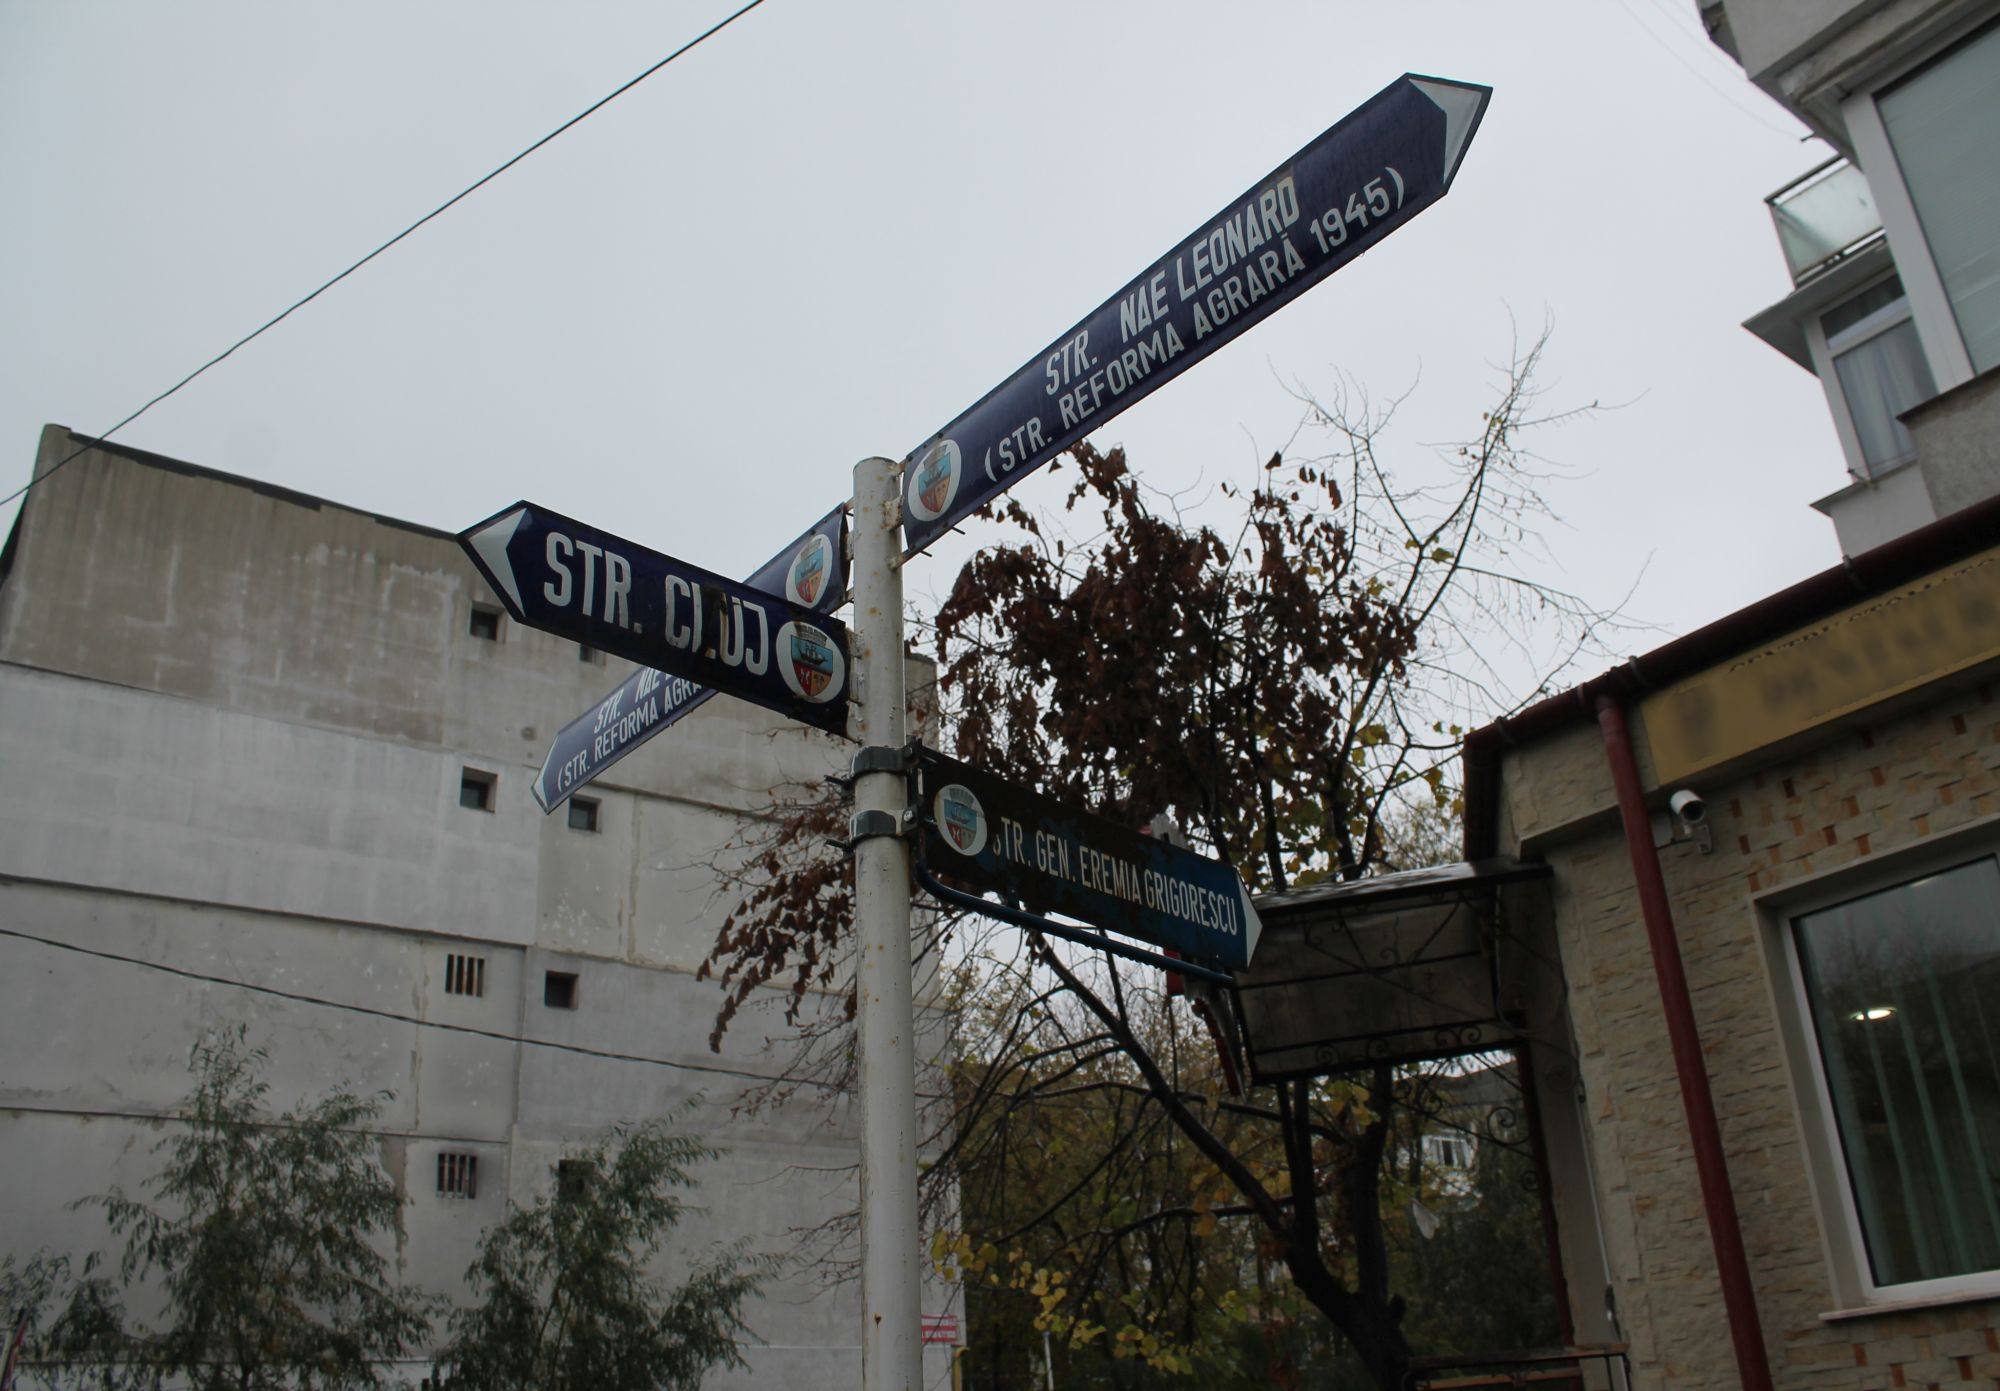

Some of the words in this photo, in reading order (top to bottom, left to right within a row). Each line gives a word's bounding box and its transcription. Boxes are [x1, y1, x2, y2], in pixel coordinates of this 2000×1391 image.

[985, 416, 1053, 482] (STR.
[1058, 322, 1185, 430] REFORMA
[1193, 232, 1306, 340] AGRARĂ
[1310, 167, 1404, 254] 1945)
[1045, 330, 1097, 396] STR.
[1120, 268, 1169, 344] NAE
[1176, 175, 1300, 302] LEONARD
[543, 531, 643, 634] STR.
[557, 749, 591, 793] (STR.
[594, 701, 659, 762] REFORMA
[594, 688, 624, 734] STR.
[1035, 830, 1076, 882] GEN.
[1079, 845, 1142, 905] EREMIA
[1144, 868, 1237, 936] GRIGORESCU
